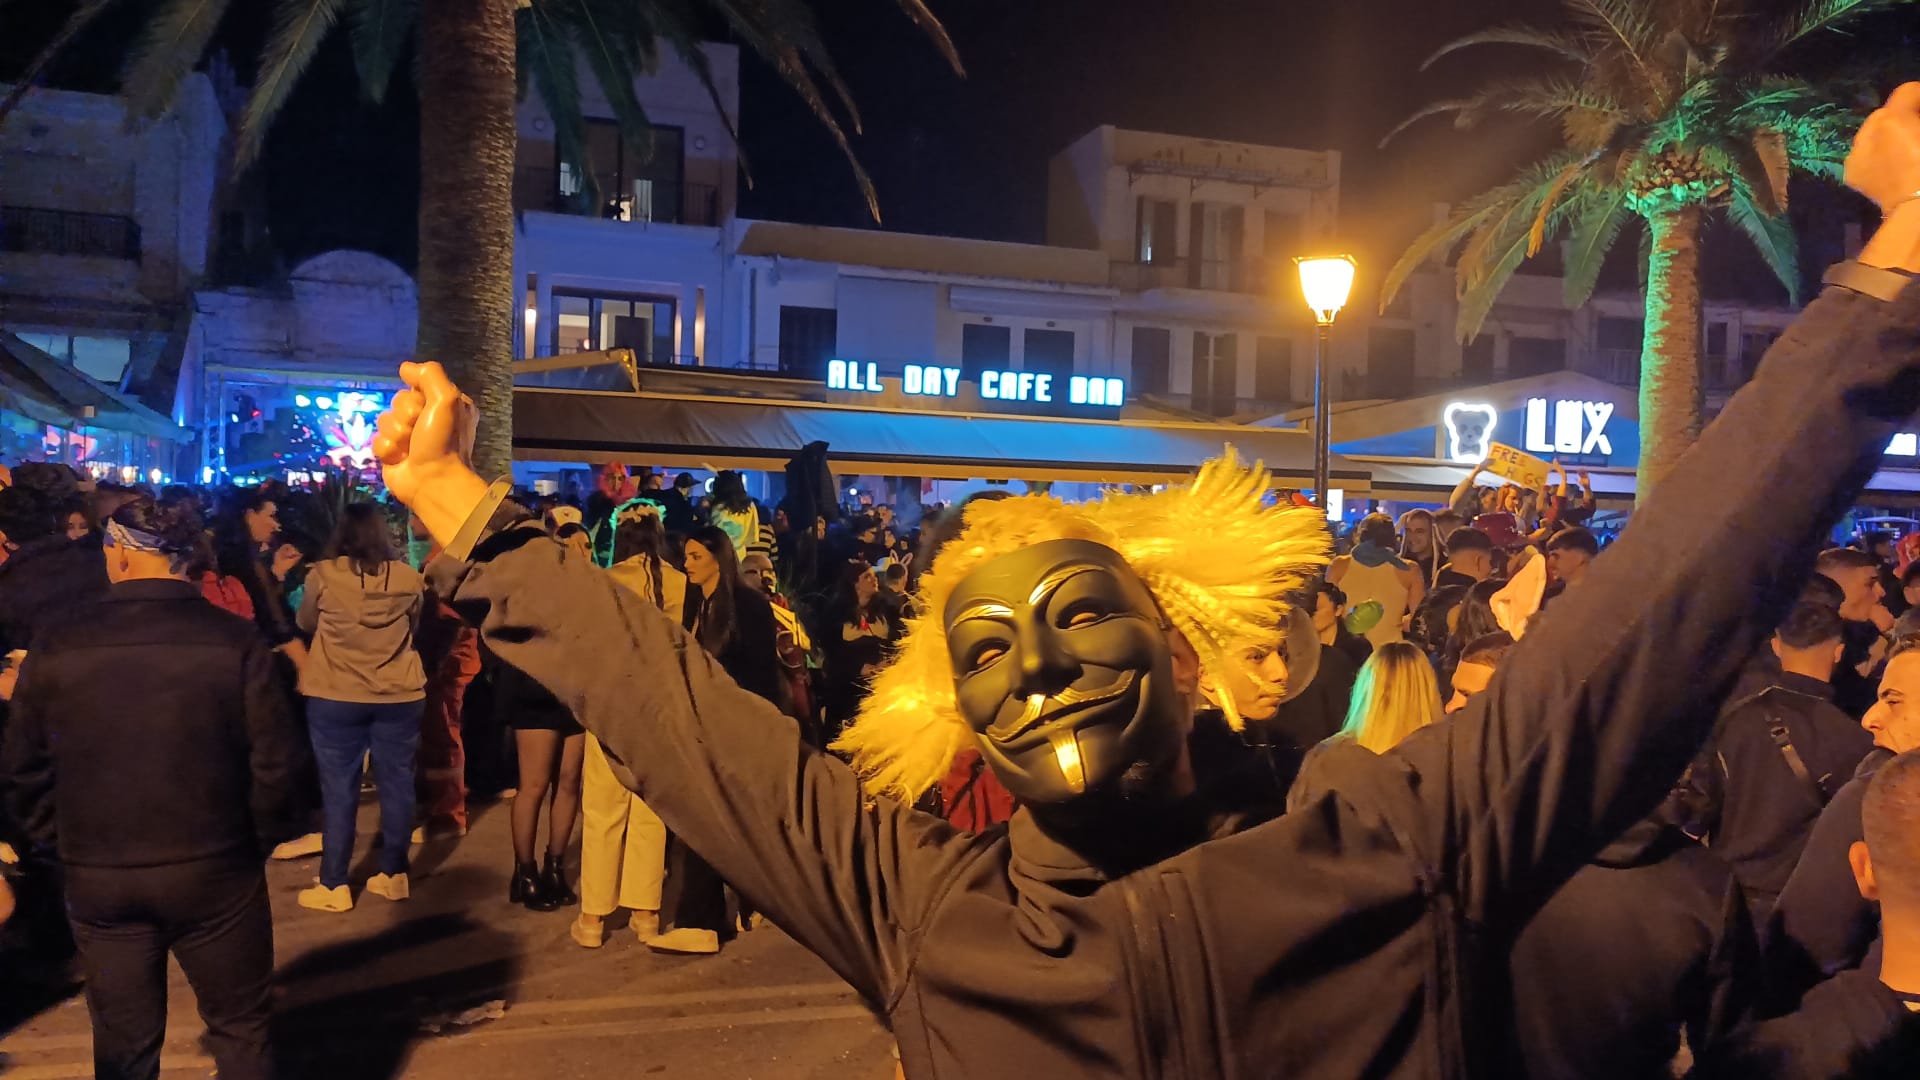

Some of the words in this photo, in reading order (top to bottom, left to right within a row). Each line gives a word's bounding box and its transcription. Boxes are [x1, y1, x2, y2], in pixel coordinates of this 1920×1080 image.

[827, 360, 884, 392] ALL
[904, 365, 961, 396] DAY
[981, 370, 1052, 402] CAFE
[1069, 376, 1125, 406] BAR
[1526, 398, 1615, 455] LUX
